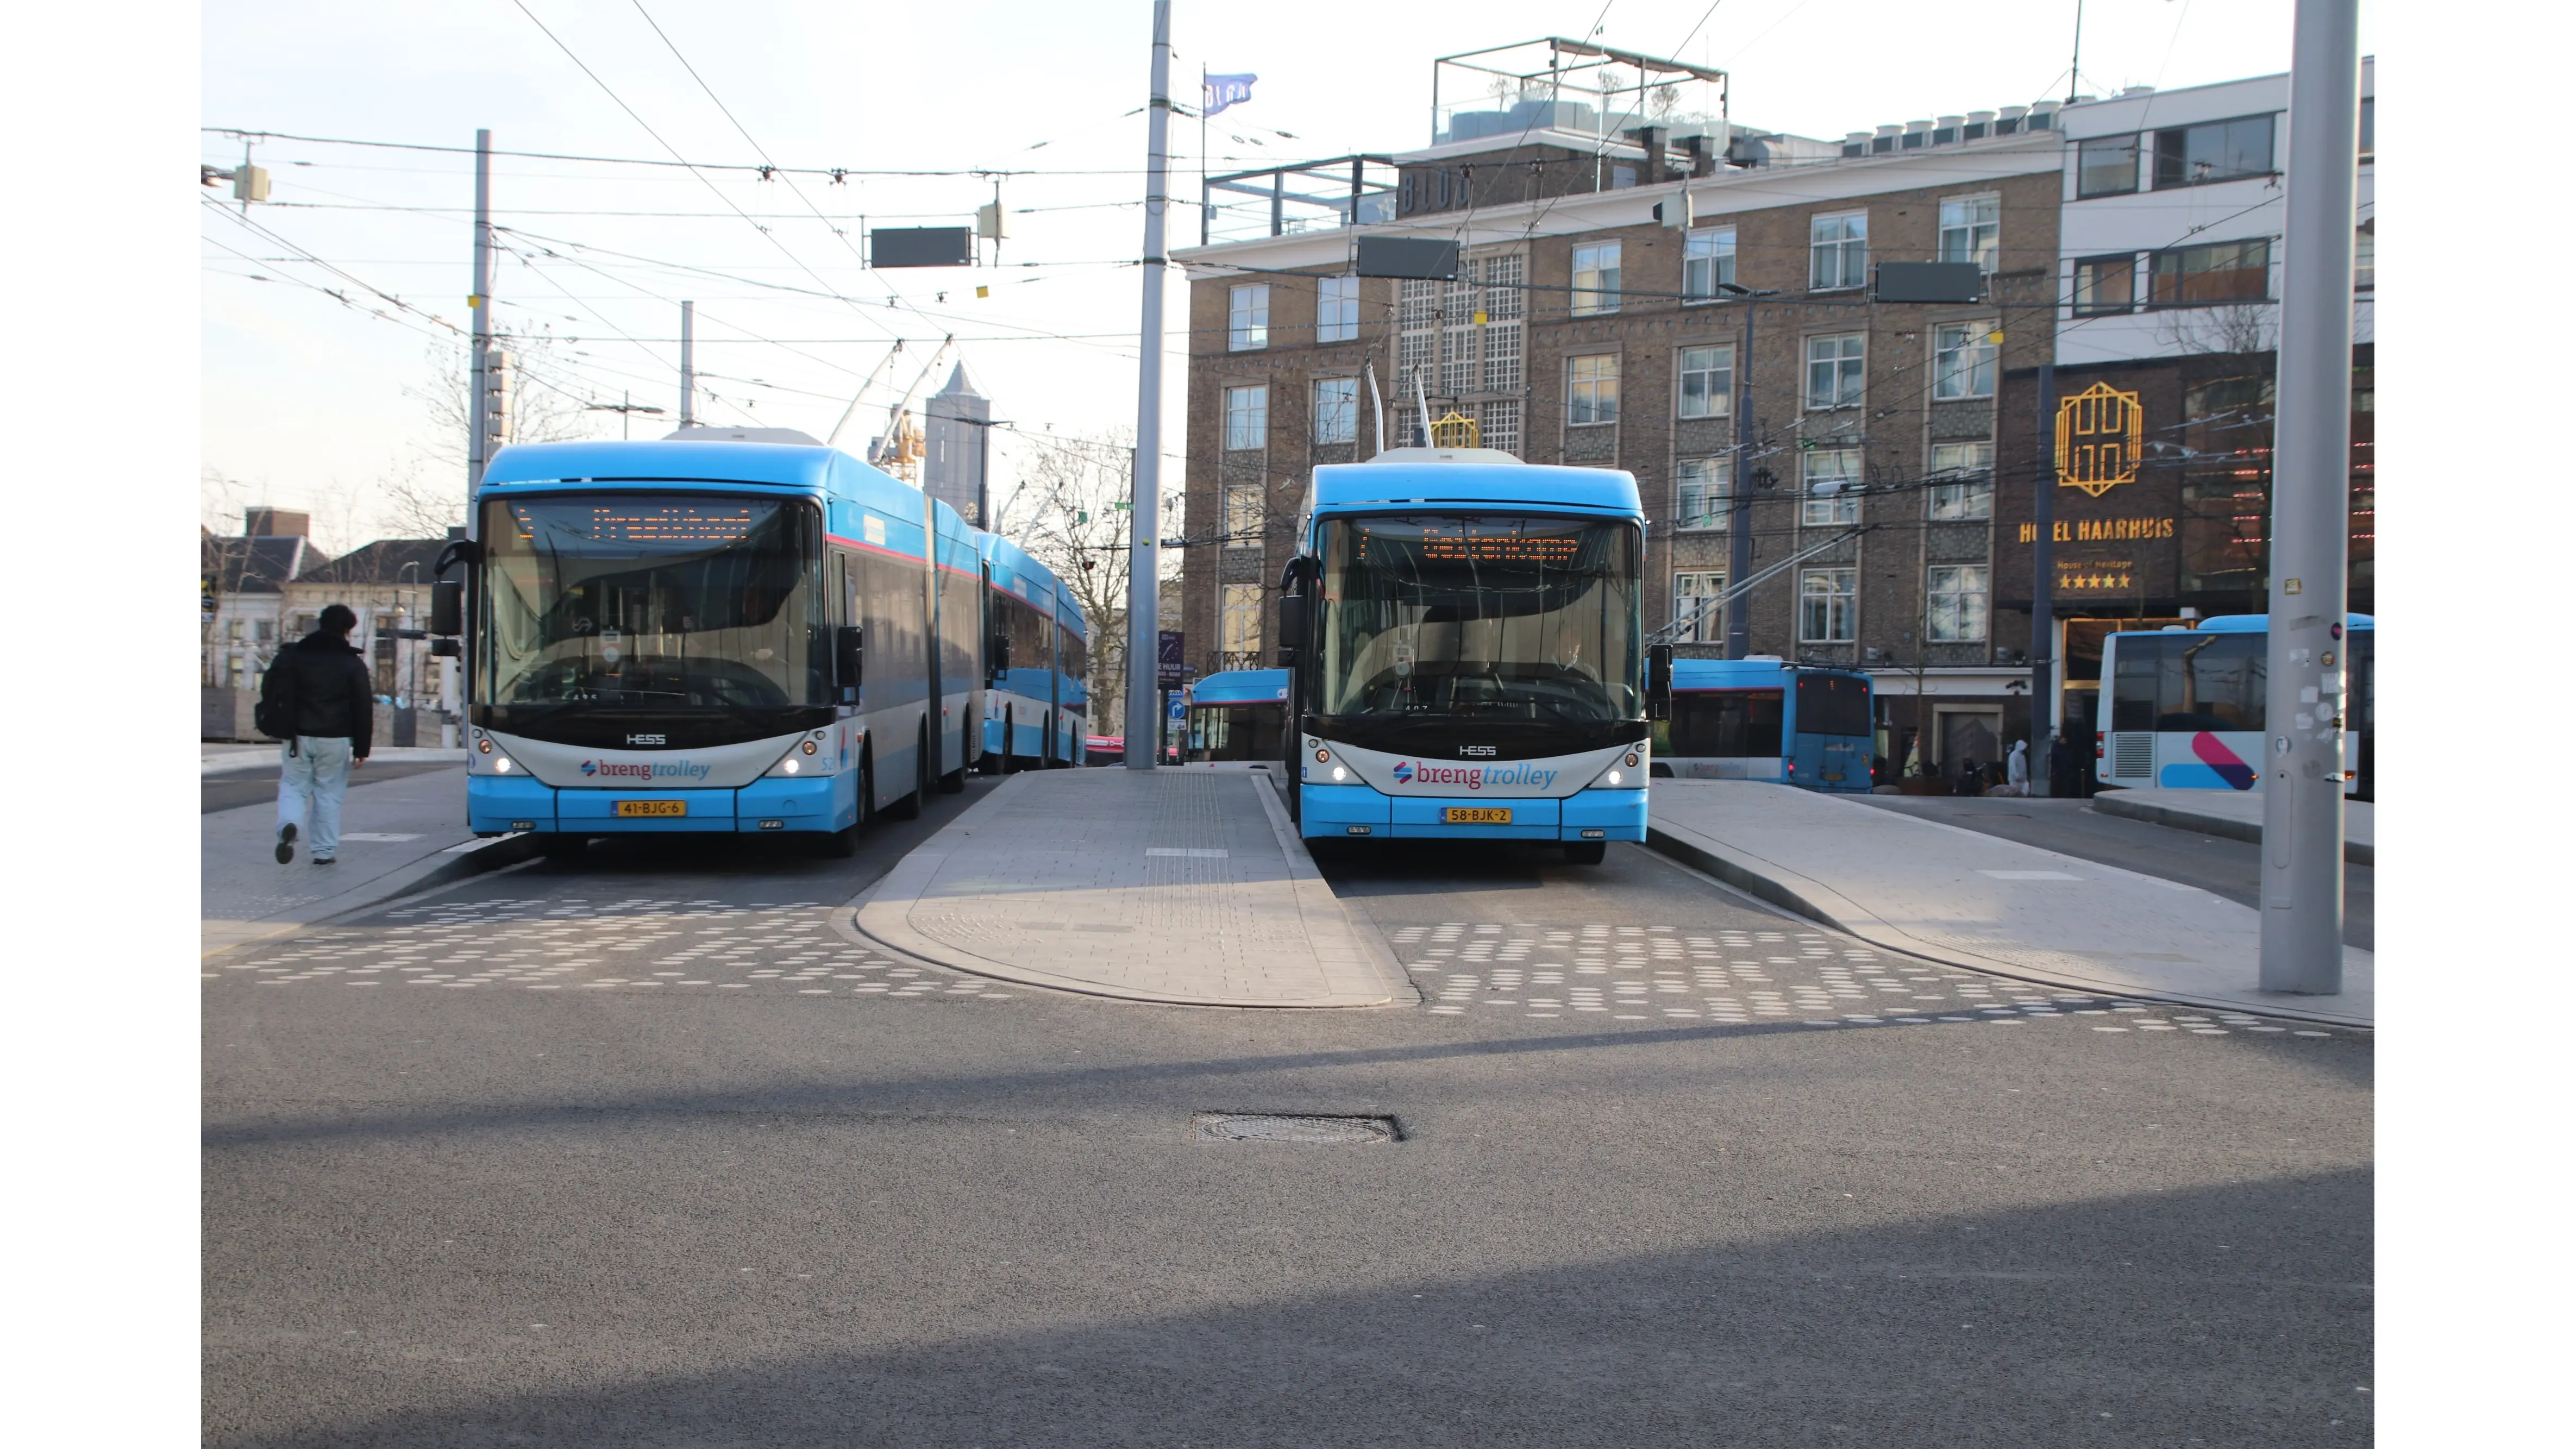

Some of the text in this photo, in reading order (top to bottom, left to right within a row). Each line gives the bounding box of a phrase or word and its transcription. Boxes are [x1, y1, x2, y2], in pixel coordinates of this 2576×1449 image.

[2020, 517, 2174, 543] HEL HAARHUIS
[2057, 560, 2082, 569] House
[626, 735, 666, 744] HESS
[1460, 746, 1496, 755] HESS
[624, 802, 679, 814] 41-BJG-6
[1451, 810, 1506, 821] 58-BJK-2
